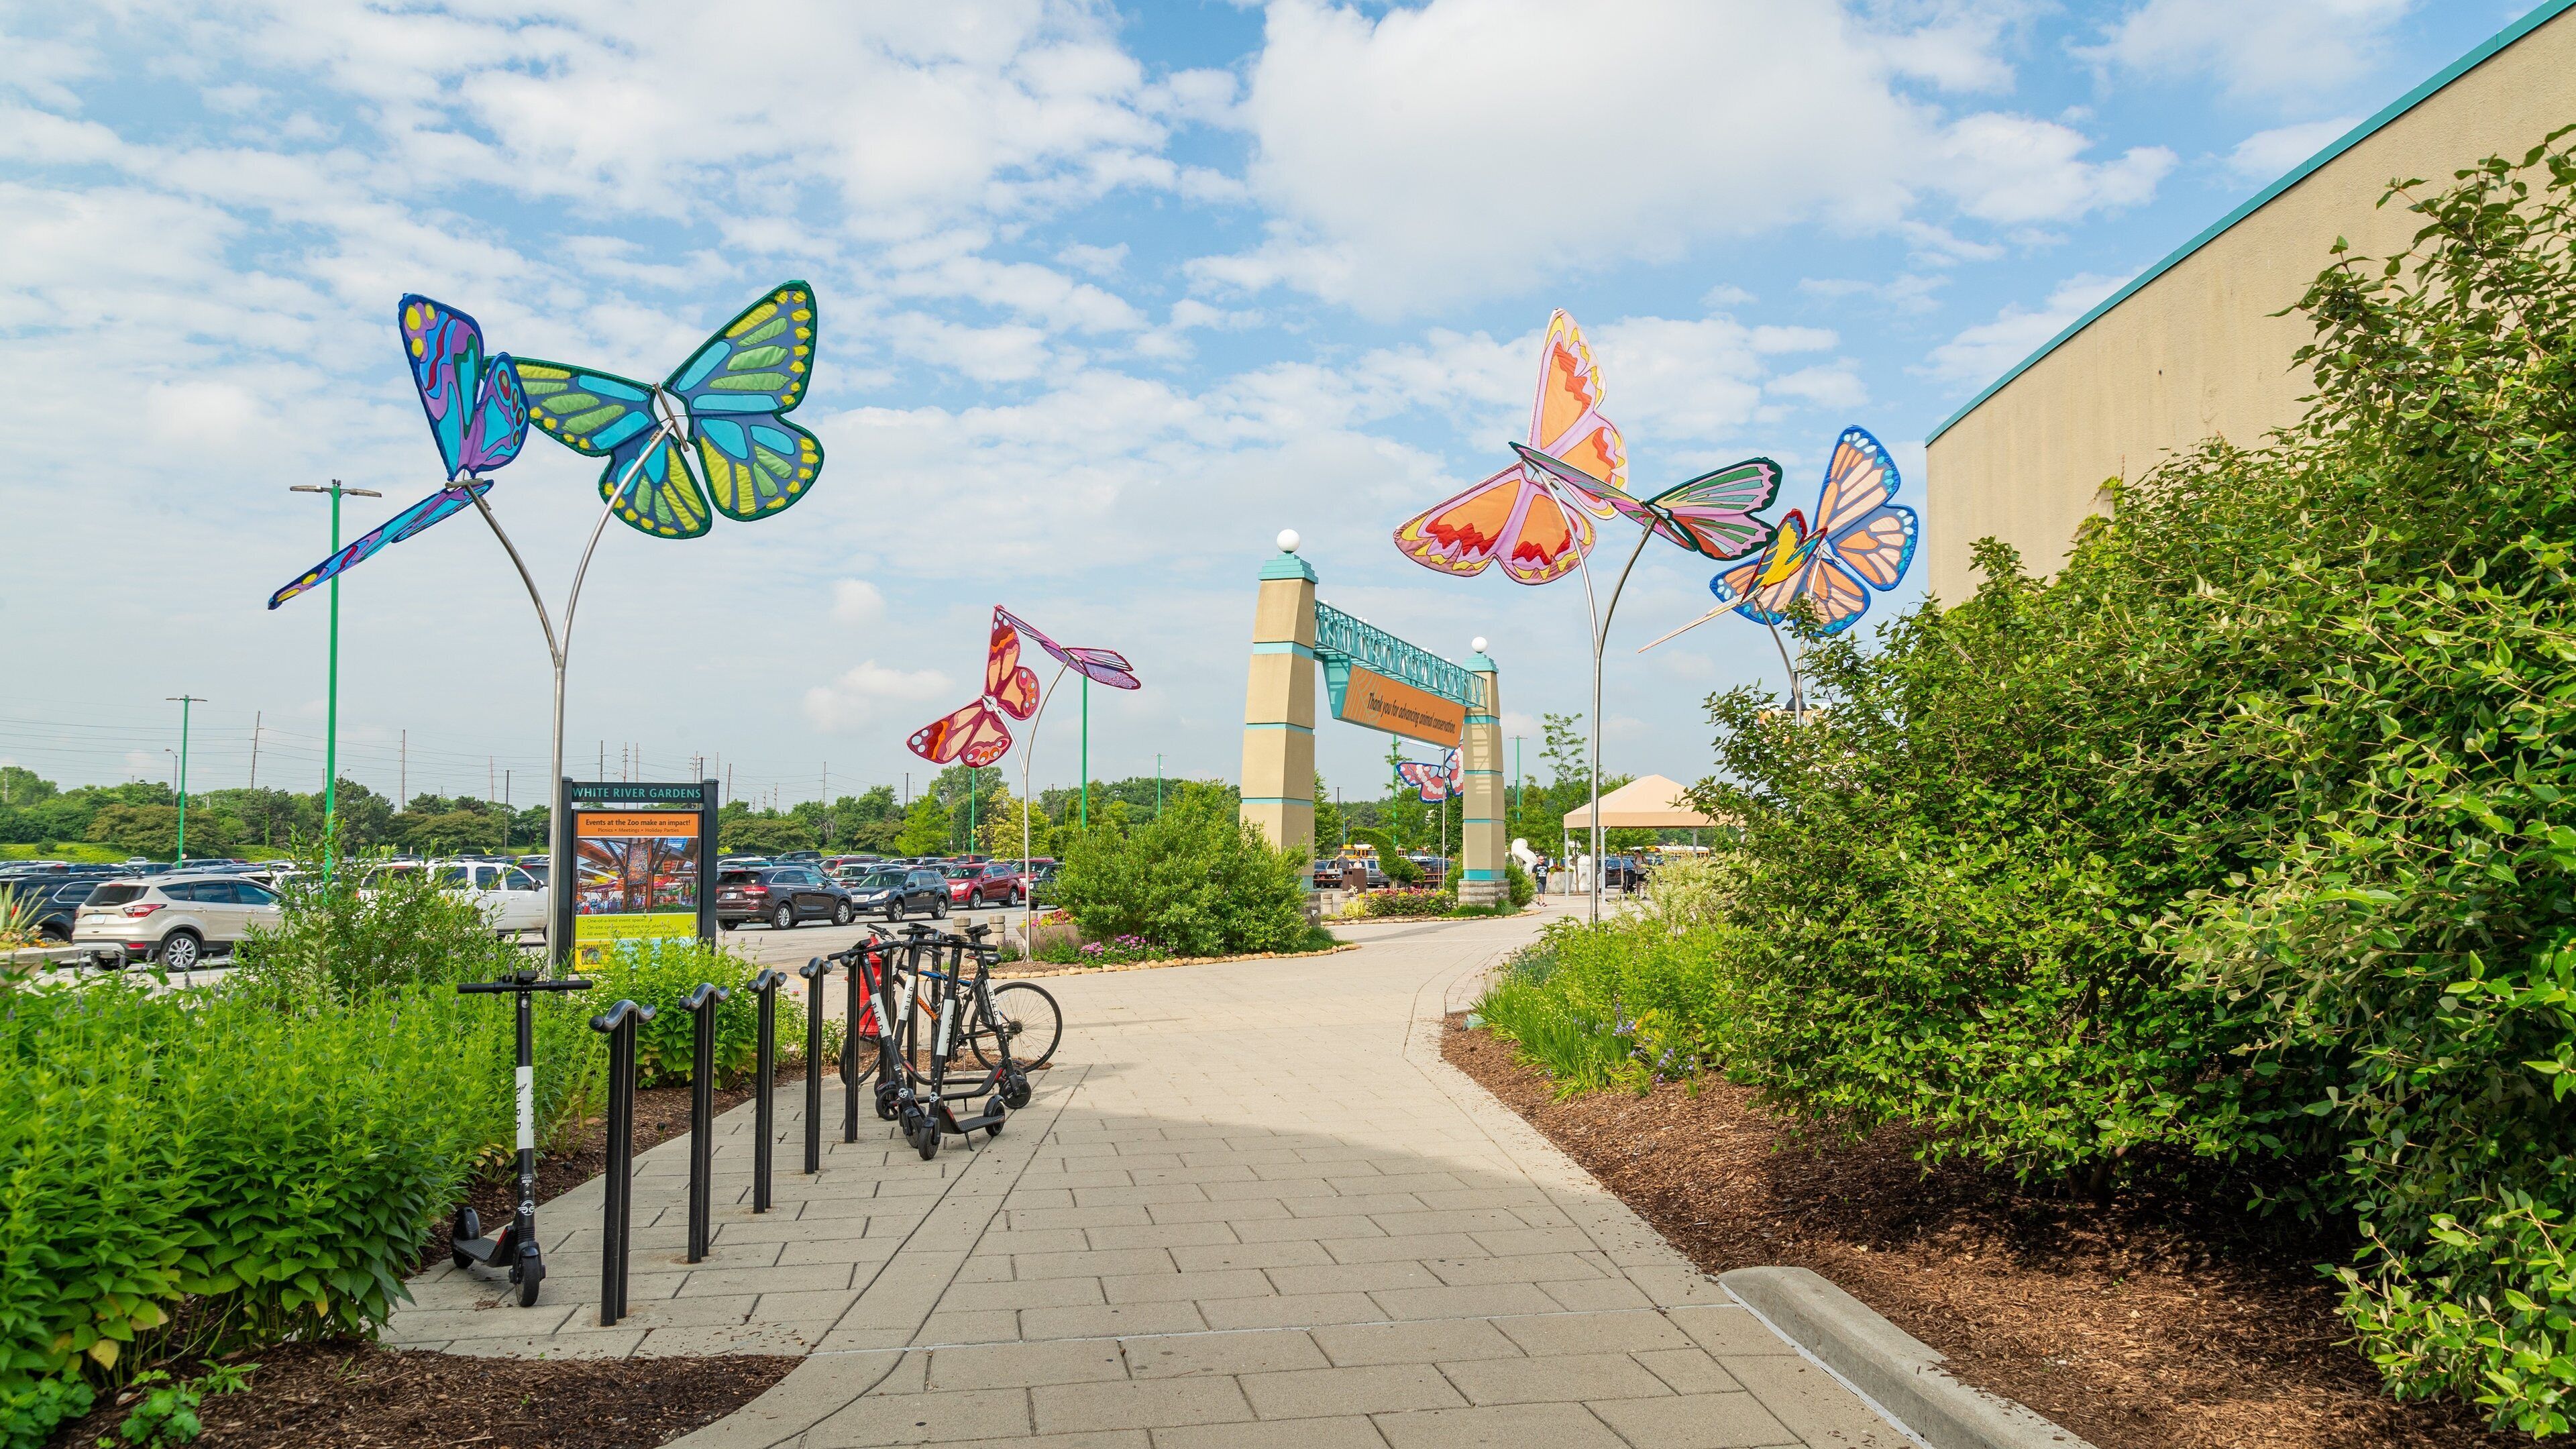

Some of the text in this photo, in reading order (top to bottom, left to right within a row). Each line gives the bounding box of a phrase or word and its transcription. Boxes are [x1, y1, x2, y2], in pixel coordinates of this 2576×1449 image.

[1367, 692, 1383, 712] Thank
[1381, 701, 1392, 718] you
[1390, 700, 1399, 717] for
[1398, 702, 1421, 728] advancing
[1419, 711, 1435, 727] animal
[572, 788, 701, 798] WHITE RIVER GARDENS
[667, 819, 690, 827] impact!
[904, 986, 914, 1010] BIRD
[989, 991, 998, 1016] BIRD
[871, 1002, 883, 1030] BIRD
